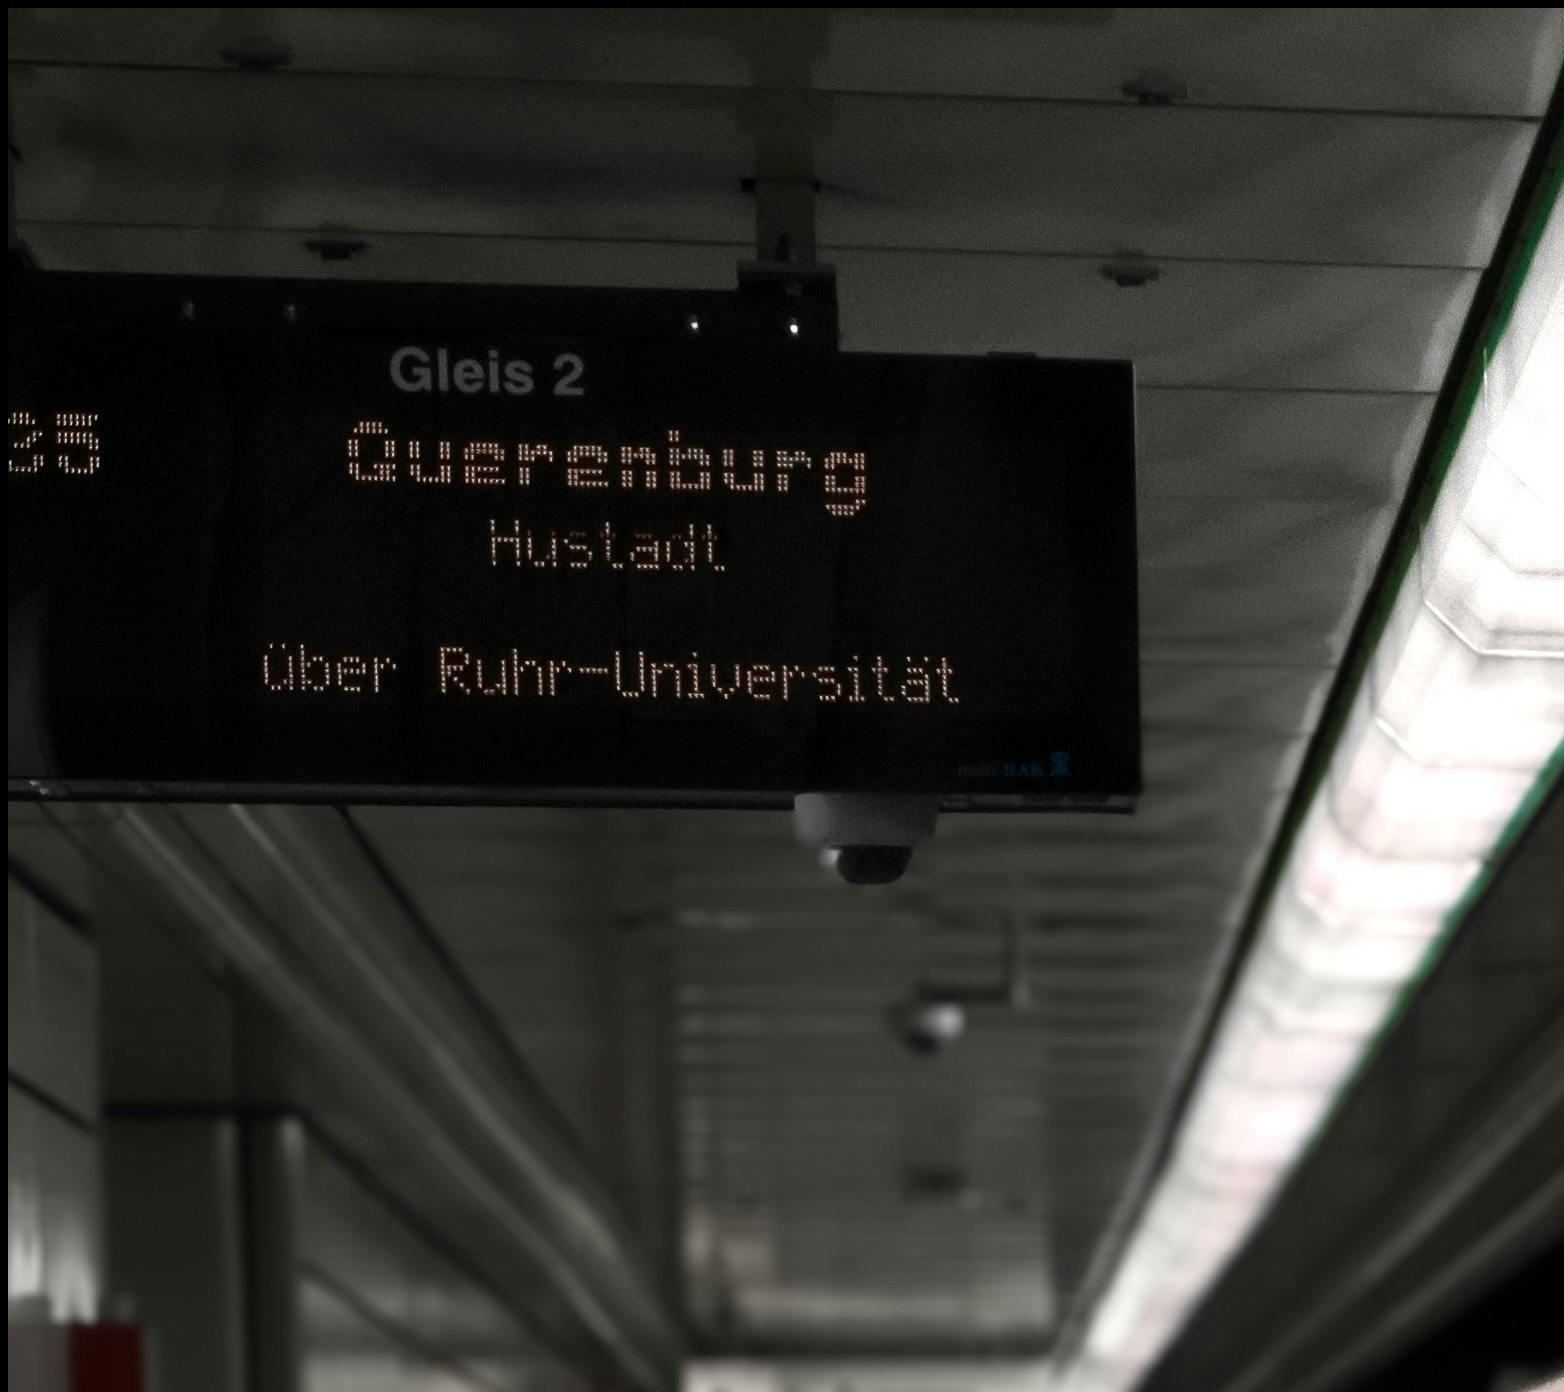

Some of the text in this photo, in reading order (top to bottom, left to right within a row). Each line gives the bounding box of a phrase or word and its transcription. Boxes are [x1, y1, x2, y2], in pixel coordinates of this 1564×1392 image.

[390, 346, 585, 396] Gleis 2
[346, 419, 869, 518] Querenburg
[488, 518, 728, 574] Hustadt
[262, 642, 961, 704] über Ruhr-Universität
